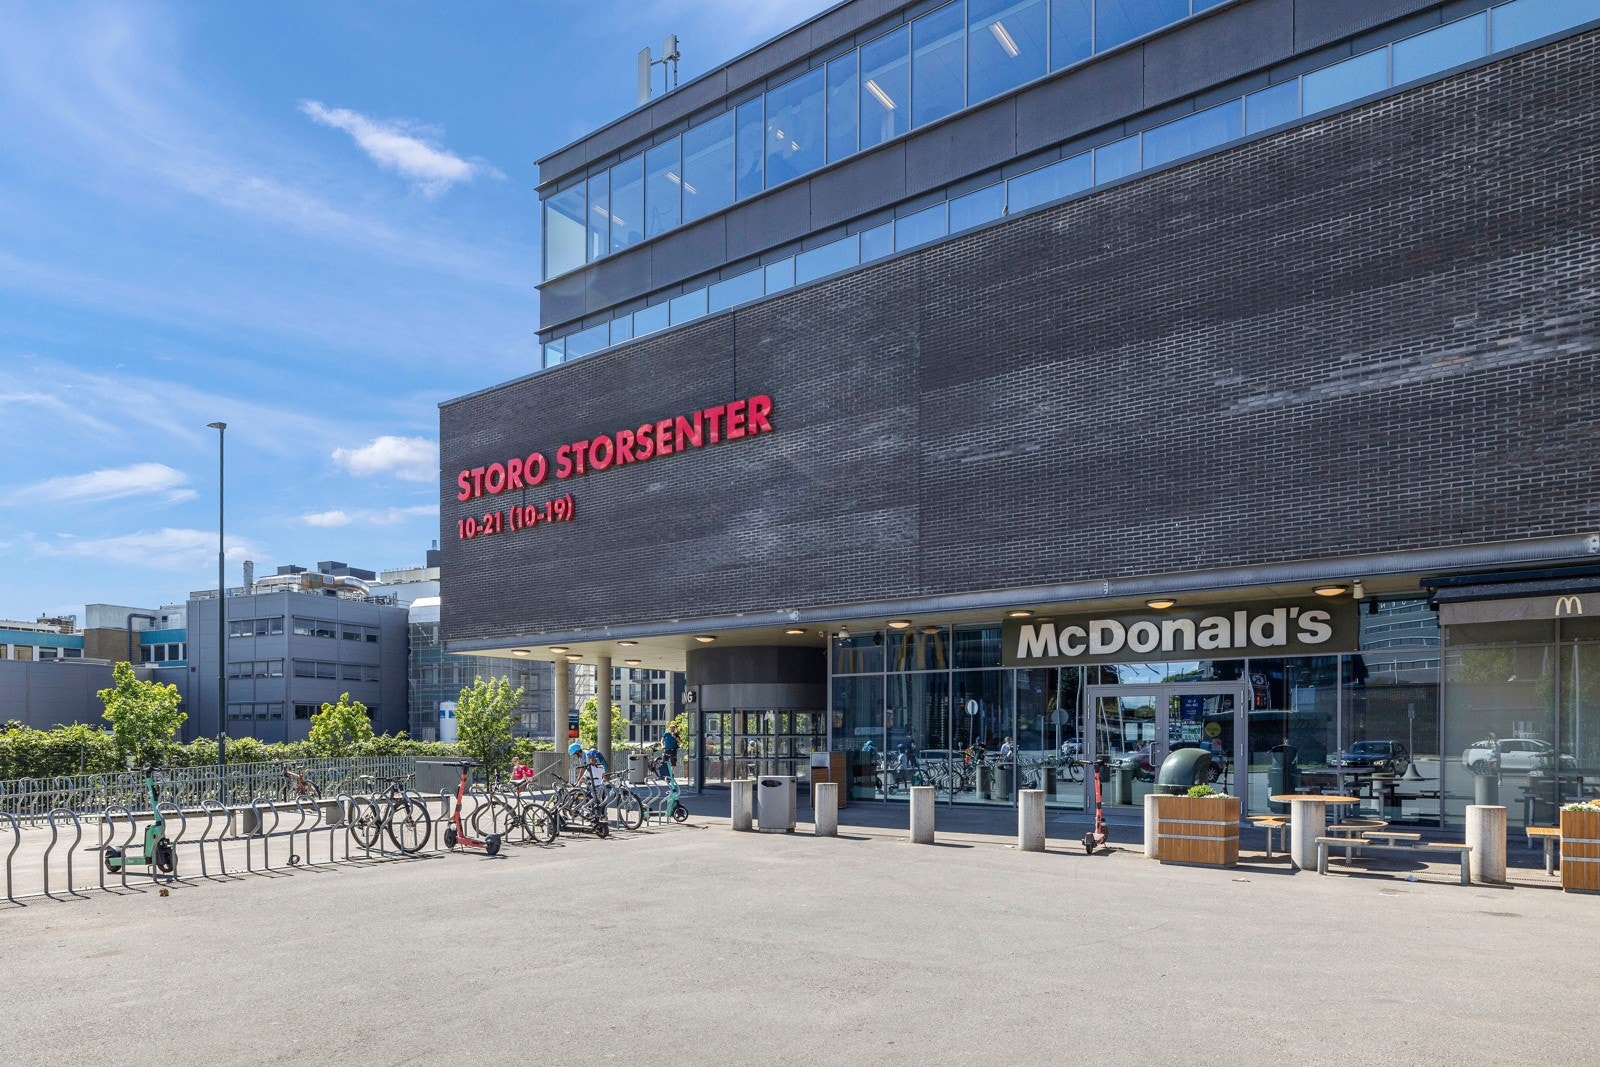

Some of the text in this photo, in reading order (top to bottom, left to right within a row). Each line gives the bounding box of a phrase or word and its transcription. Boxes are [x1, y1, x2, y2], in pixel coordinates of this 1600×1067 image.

[457, 394, 774, 501] STORO STORSENTER
[457, 493, 575, 539] 10-21 (10-19)
[1016, 607, 1333, 659] McDonald's
